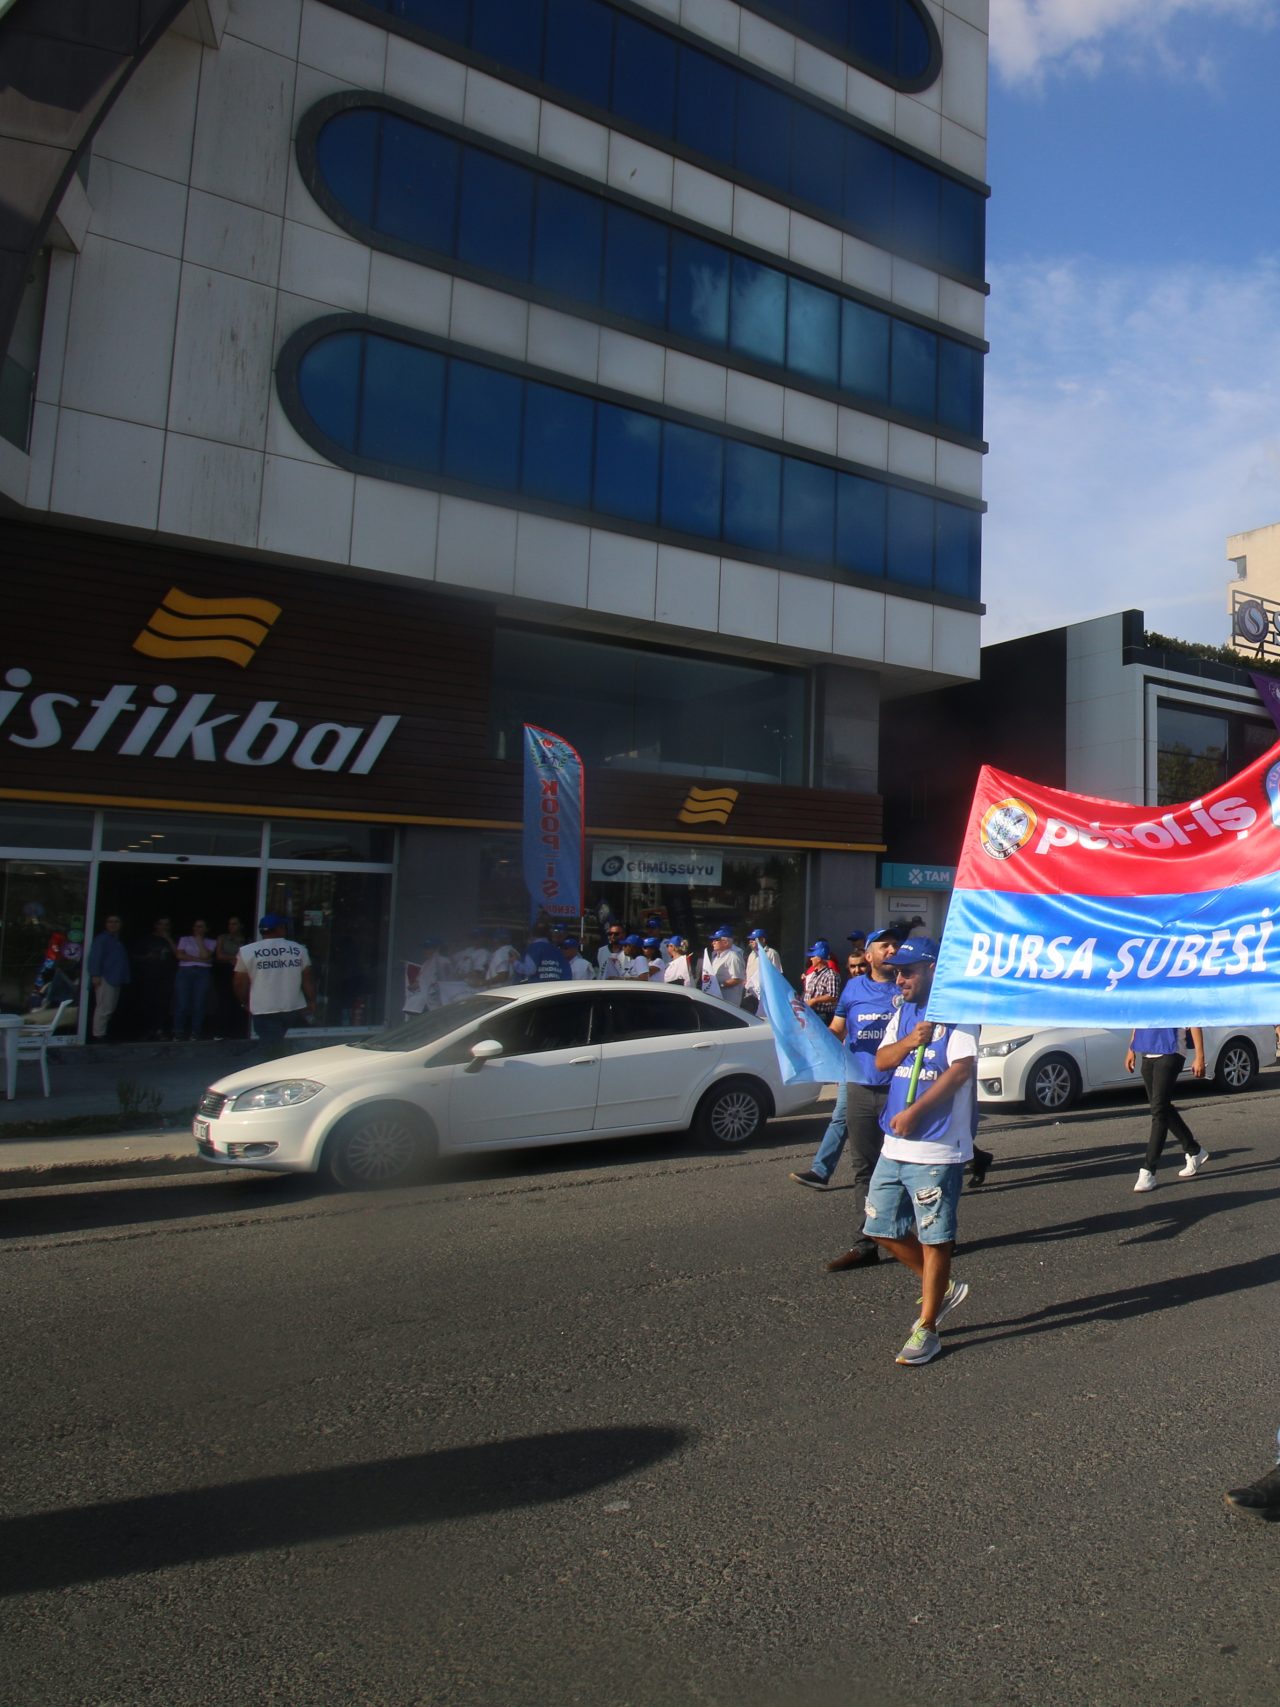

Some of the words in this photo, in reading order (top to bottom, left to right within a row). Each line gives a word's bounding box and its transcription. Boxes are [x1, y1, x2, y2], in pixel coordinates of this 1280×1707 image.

[0, 667, 401, 775] istikbal
[626, 861, 715, 877] GÜMÜŞSUYU
[924, 870, 950, 881] TAM
[964, 932, 1098, 980] BURSA
[1105, 907, 1275, 992] ŞUBESİ
